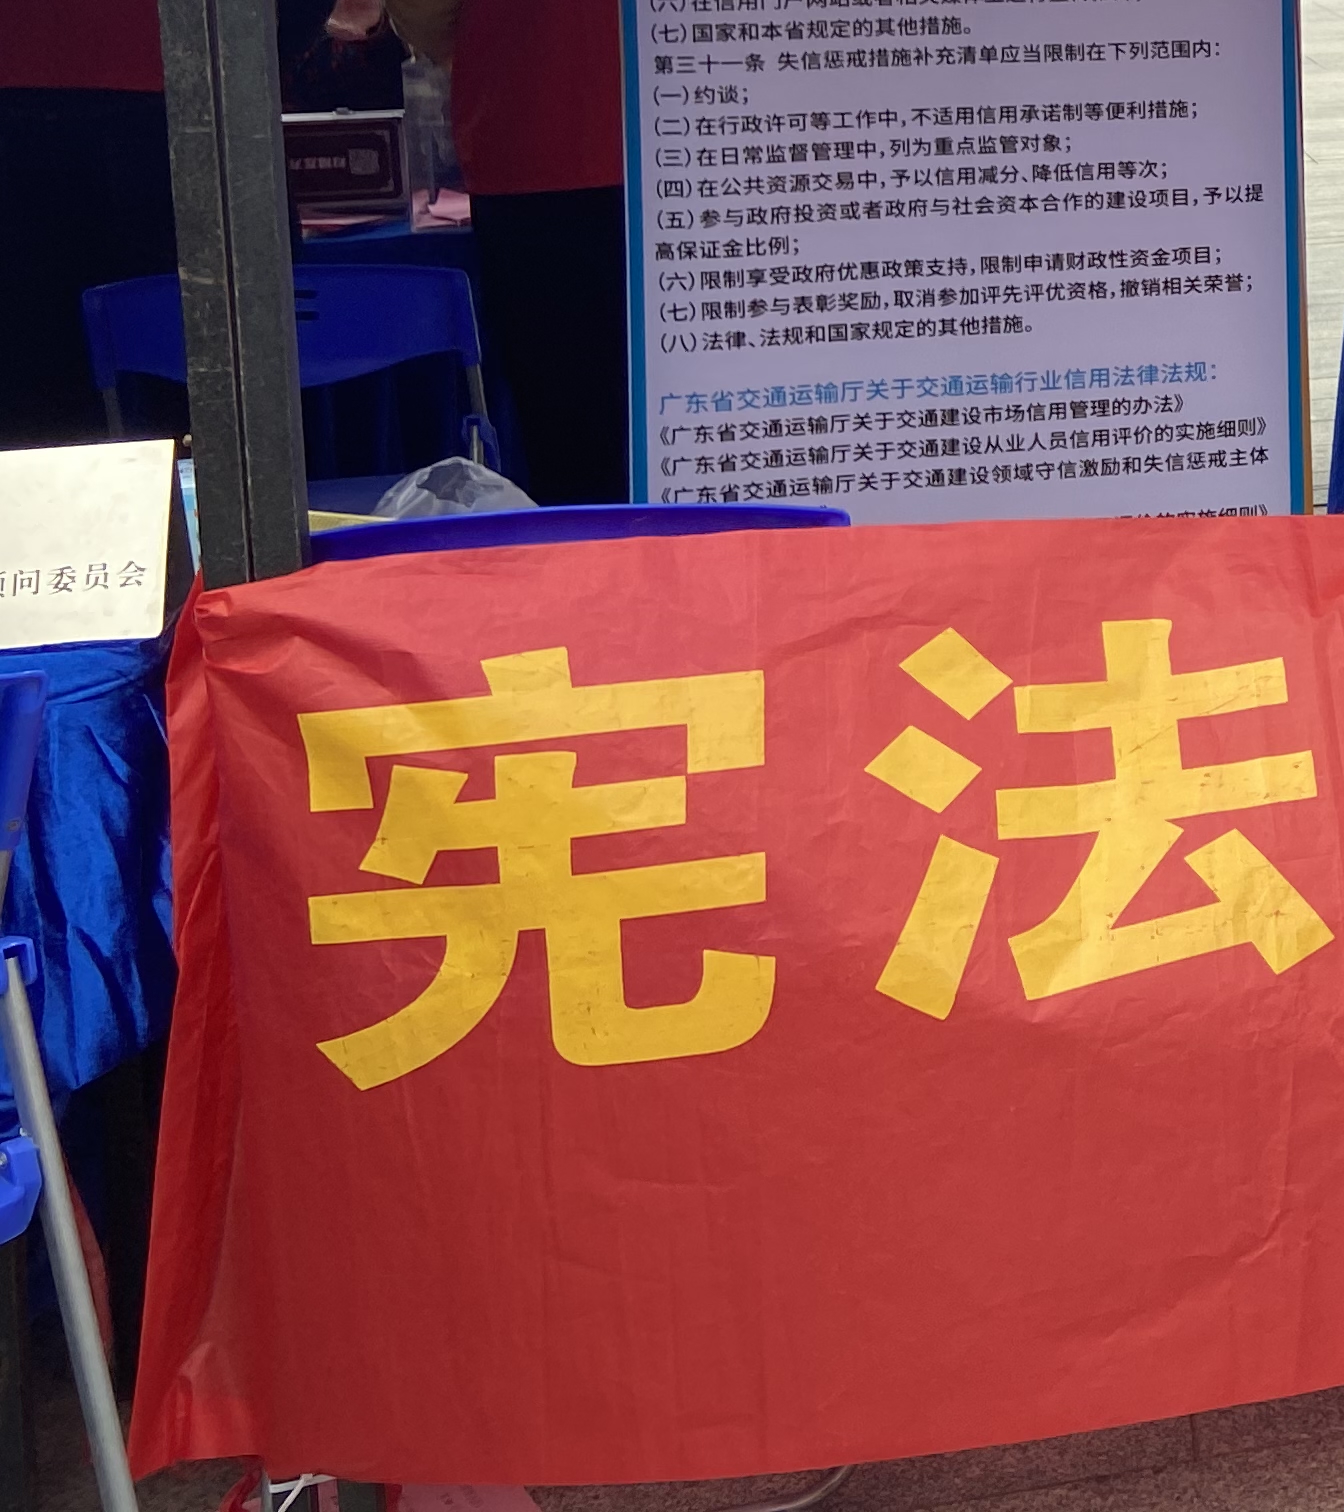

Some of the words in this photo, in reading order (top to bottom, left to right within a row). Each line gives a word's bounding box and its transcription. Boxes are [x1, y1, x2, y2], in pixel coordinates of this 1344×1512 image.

[654, 85, 749, 107] （一）约谈；
[655, 236, 800, 261] 高保证金比例；
